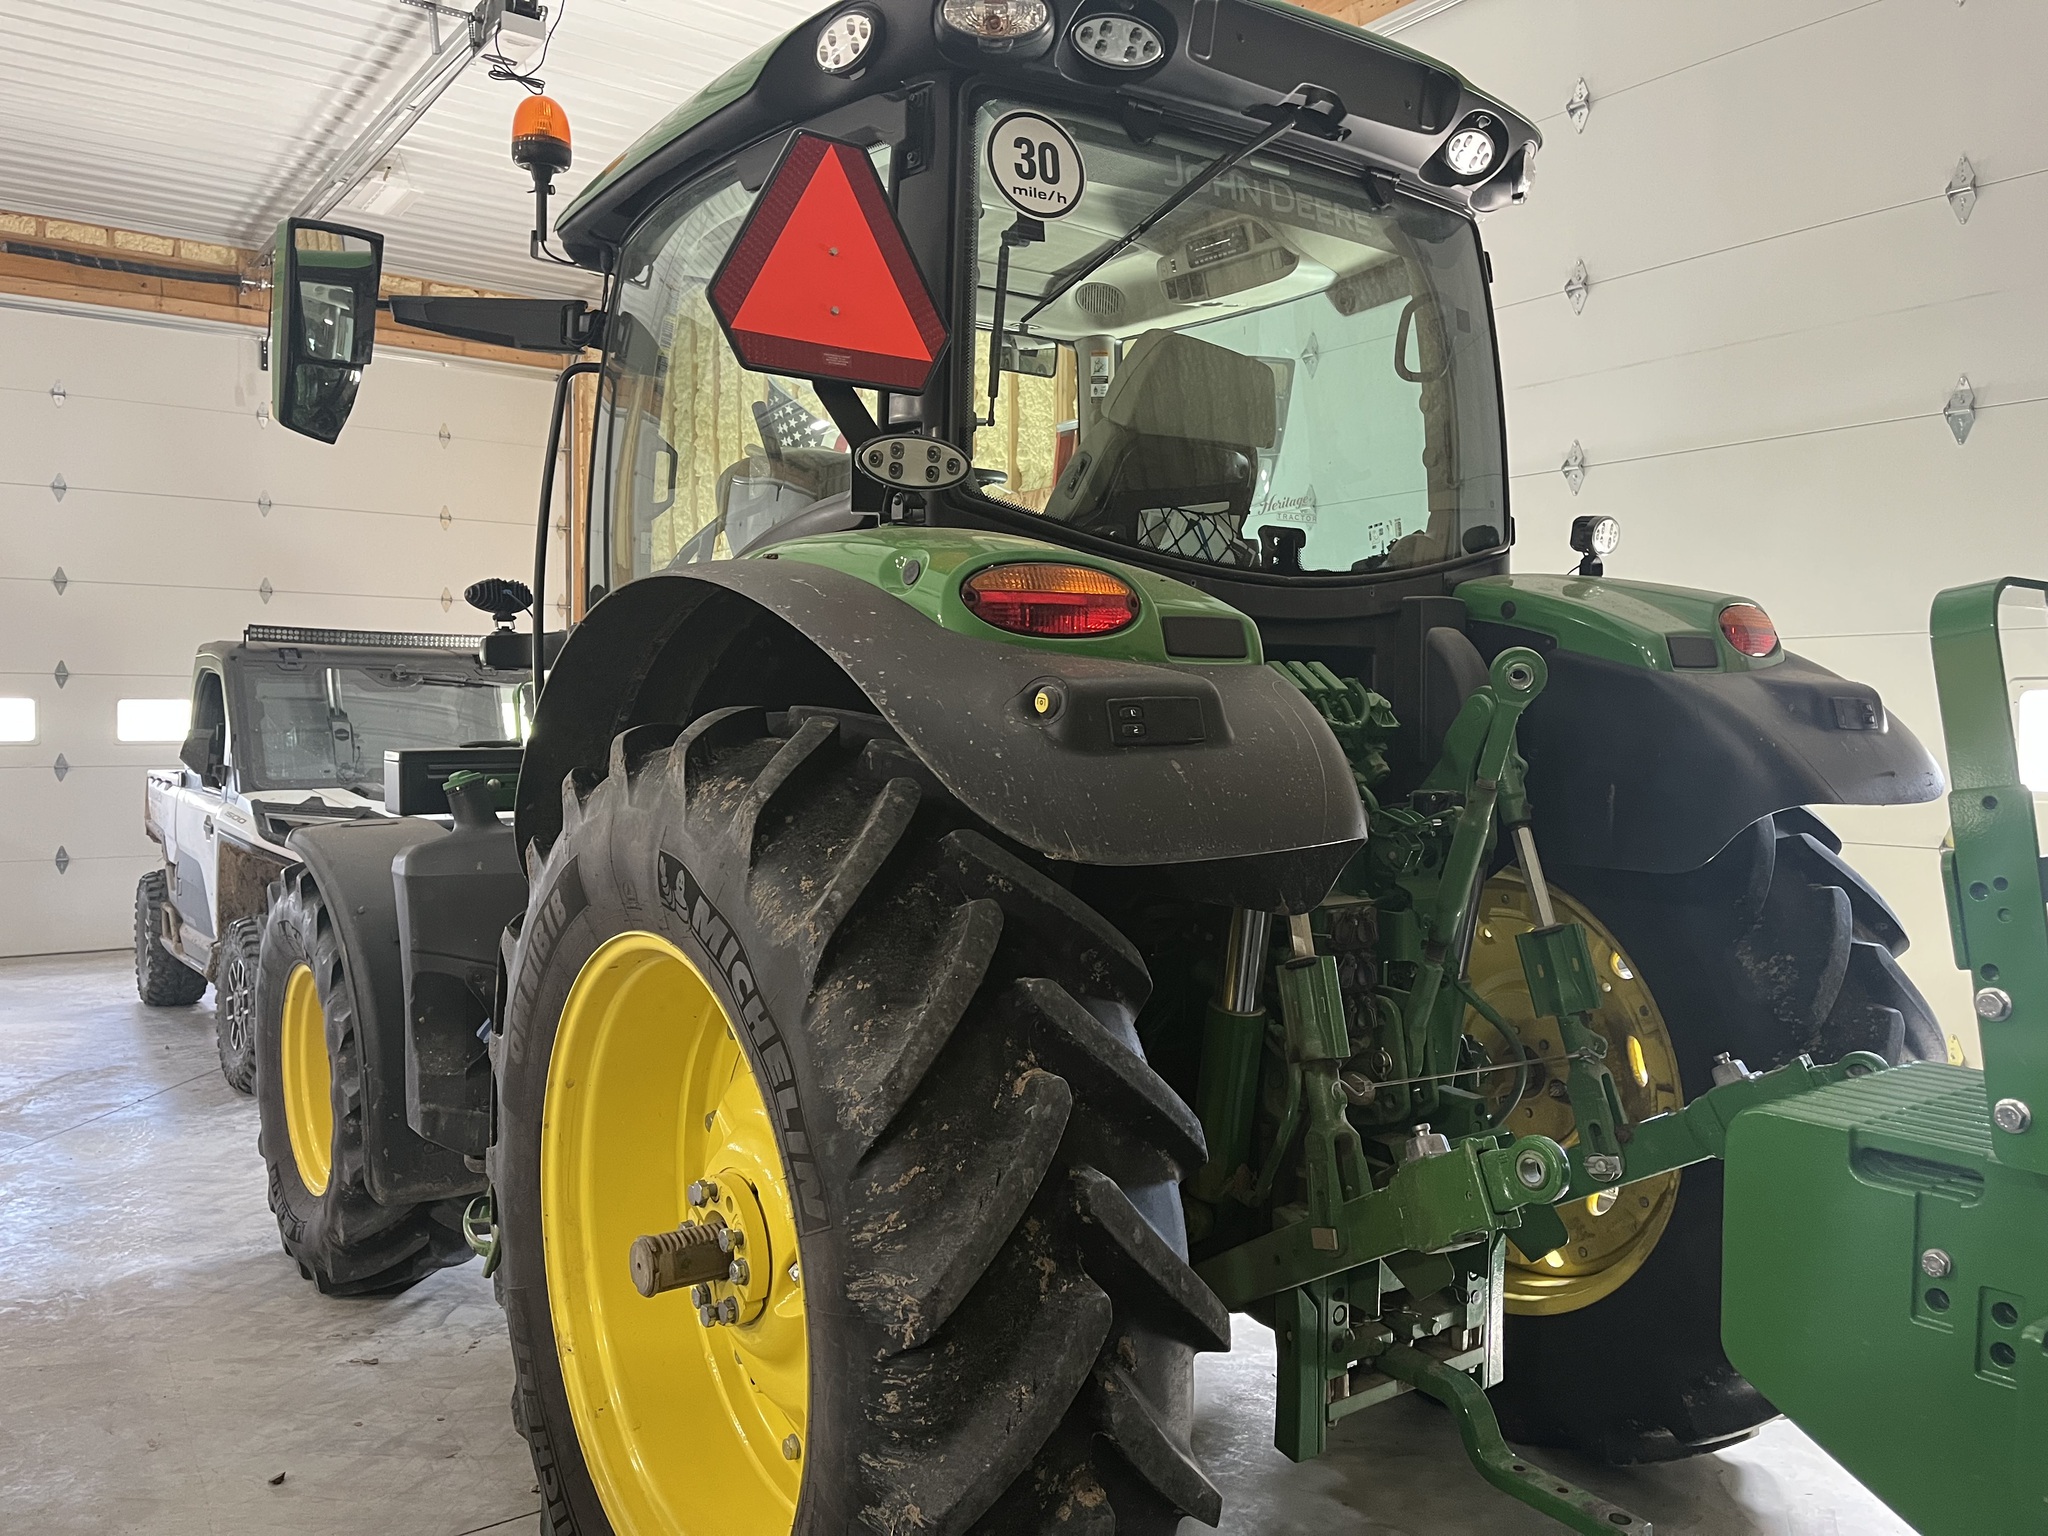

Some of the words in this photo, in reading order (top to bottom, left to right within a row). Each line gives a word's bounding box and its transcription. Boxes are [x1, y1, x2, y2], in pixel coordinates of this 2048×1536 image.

[1013, 136, 1061, 185] 30
[1013, 186, 1067, 205] mile/h
[1268, 179, 1372, 237] DEERE
[1258, 493, 1309, 516] Heritage
[1277, 512, 1317, 522] TRACTOR
[509, 887, 567, 1065] OMNIBIB
[692, 894, 828, 1222] MICHELIN
